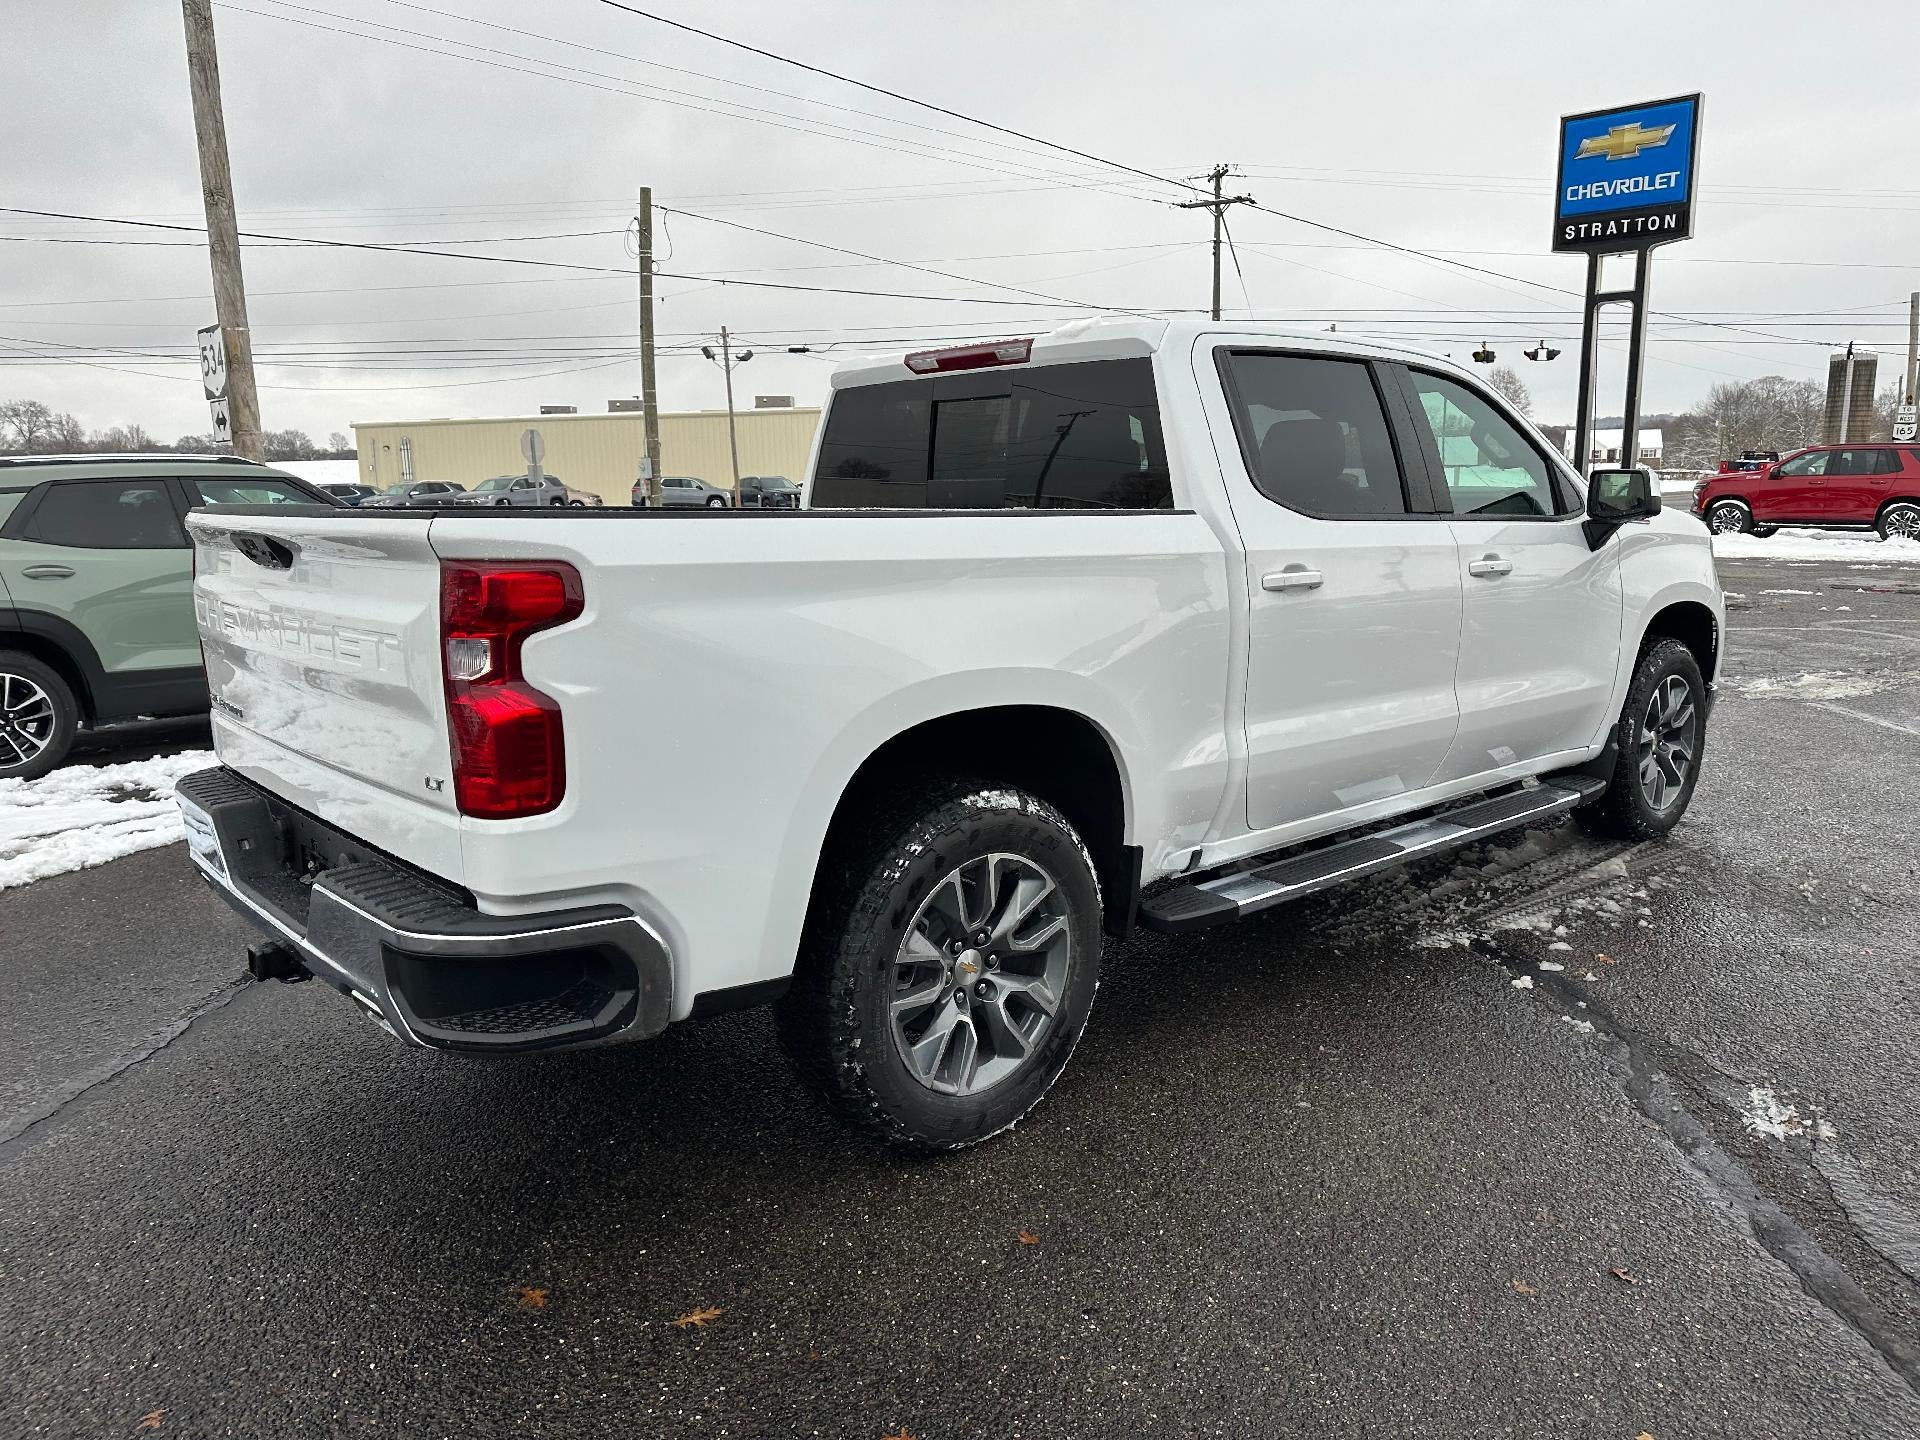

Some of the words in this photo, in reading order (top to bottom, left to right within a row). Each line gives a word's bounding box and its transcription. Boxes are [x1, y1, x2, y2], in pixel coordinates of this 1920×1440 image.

[1566, 171, 1681, 201] CHEVROLET
[1565, 213, 1677, 240] STRATTON
[201, 341, 225, 377] 534
[1896, 426, 1913, 435] 165
[424, 776, 445, 793] LT
